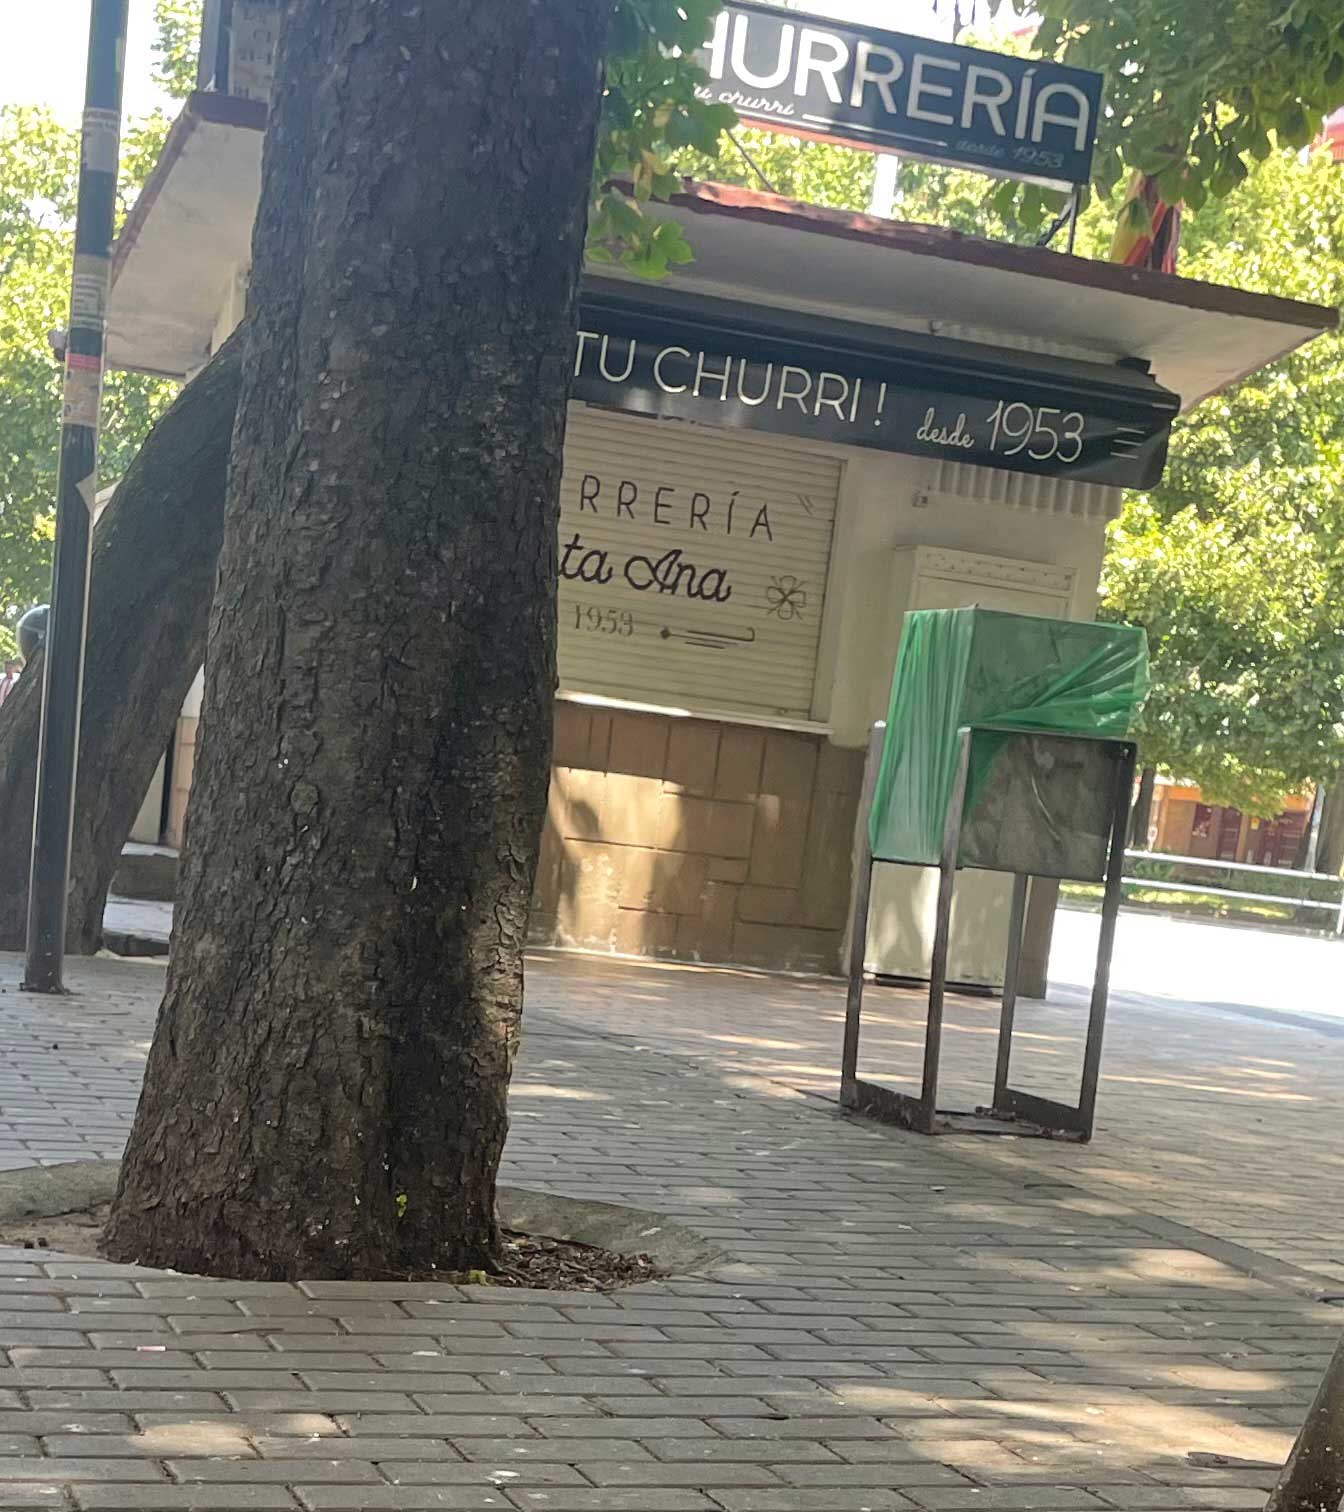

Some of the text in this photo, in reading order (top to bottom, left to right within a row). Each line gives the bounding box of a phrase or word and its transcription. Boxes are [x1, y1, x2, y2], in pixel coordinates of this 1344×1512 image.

[1013, 145, 1065, 169] 1953
[573, 330, 637, 382] TU
[916, 399, 1085, 463] desde 1953
[580, 474, 773, 542] RRERÍA
[559, 533, 732, 603] ta Ana
[574, 603, 634, 638] 1953
